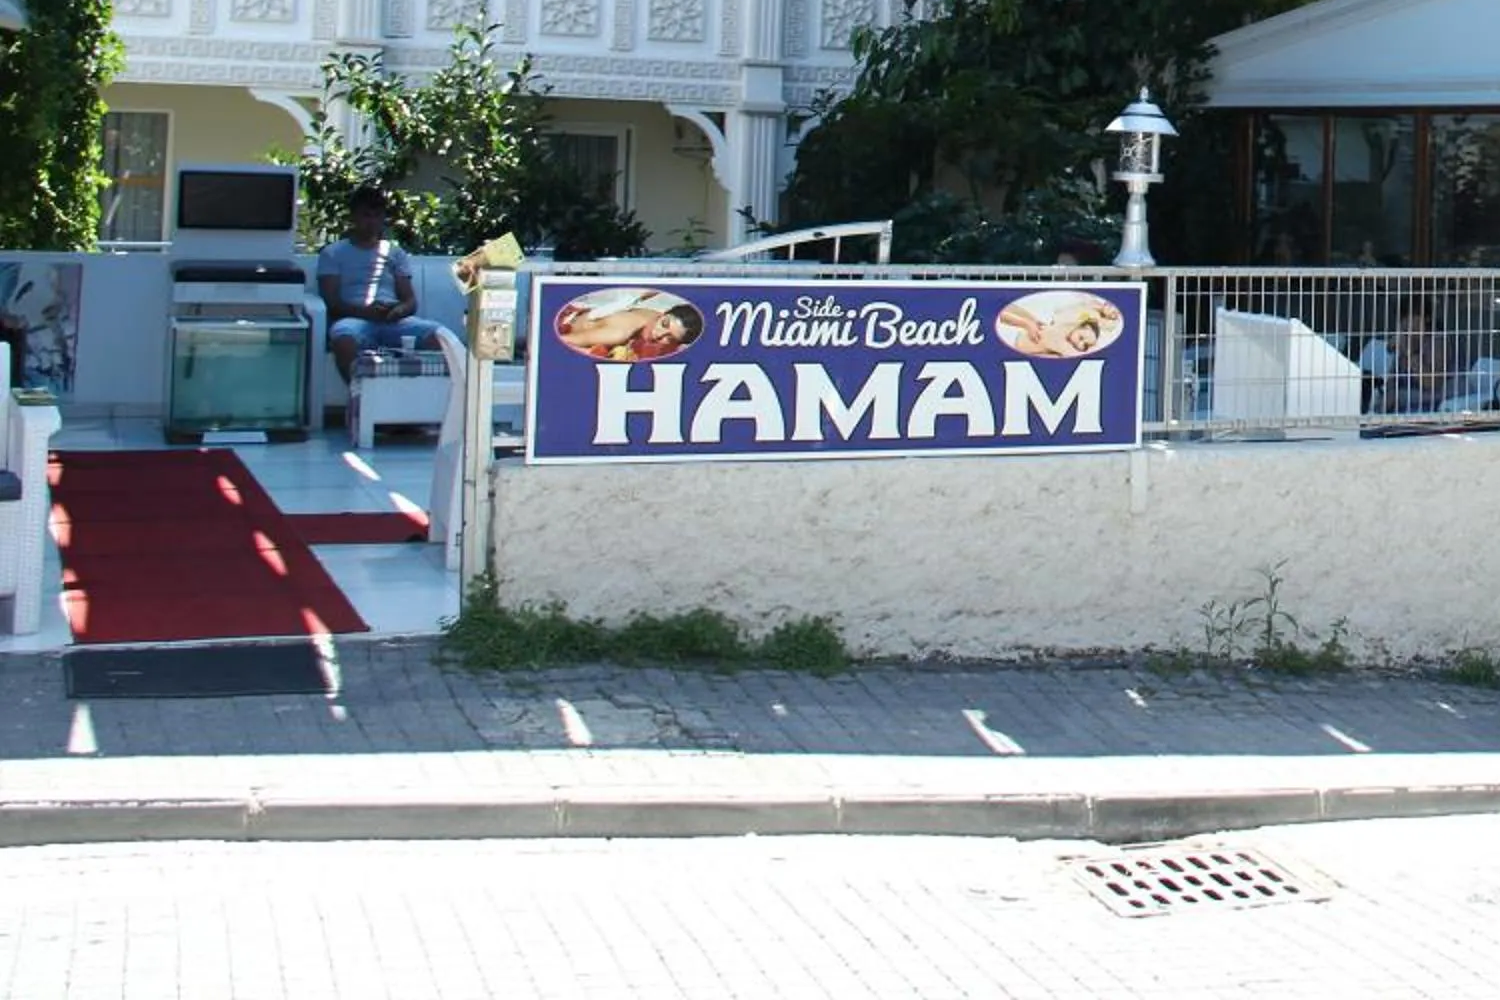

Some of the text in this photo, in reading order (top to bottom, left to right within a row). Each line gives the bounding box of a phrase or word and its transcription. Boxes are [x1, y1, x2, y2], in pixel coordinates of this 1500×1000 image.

[716, 297, 985, 349] Miami Beach
[793, 295, 843, 318] Side
[591, 358, 1106, 446] HAMAM
